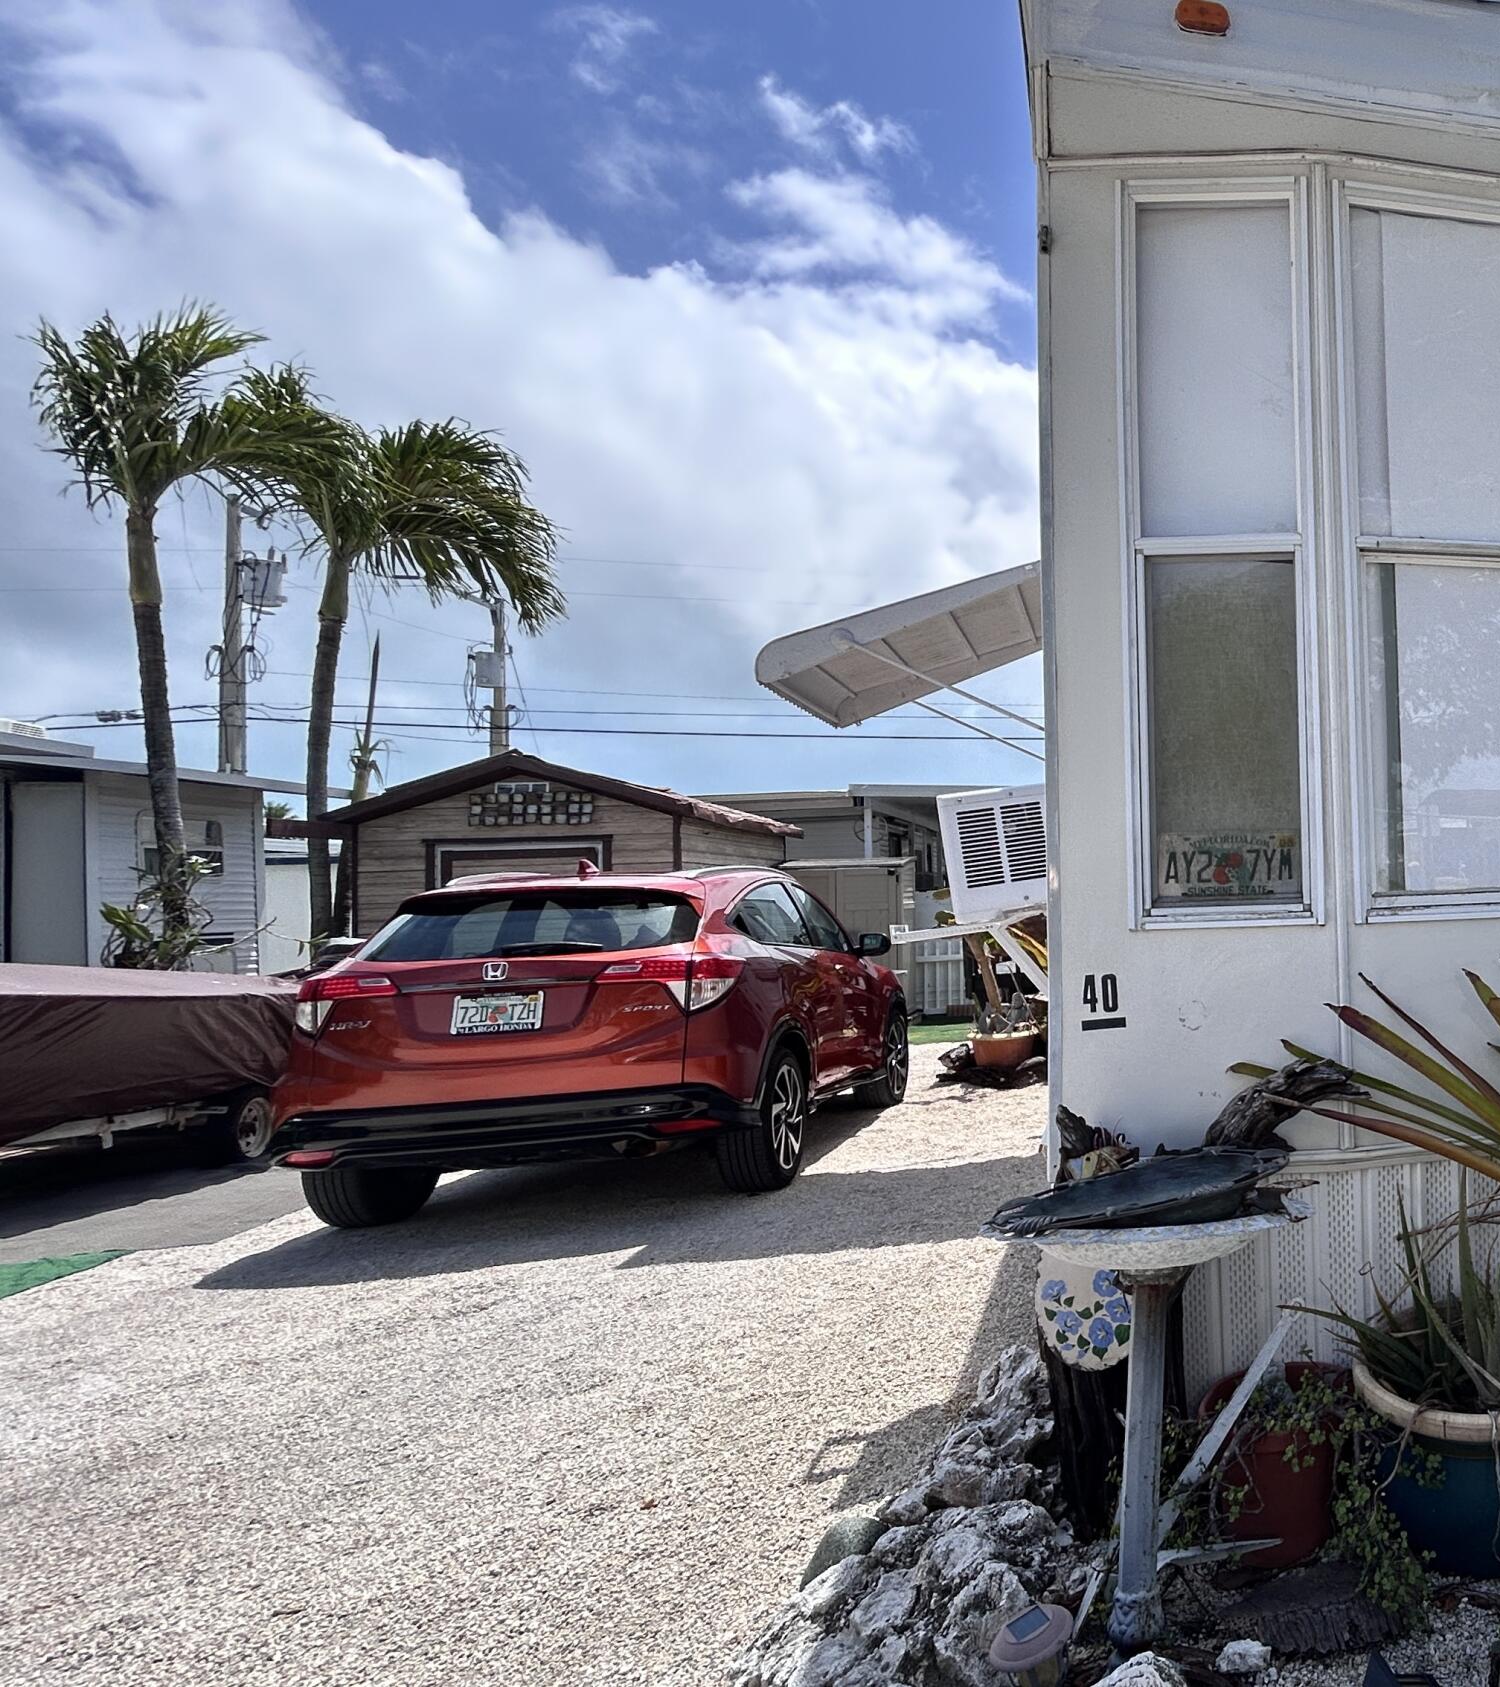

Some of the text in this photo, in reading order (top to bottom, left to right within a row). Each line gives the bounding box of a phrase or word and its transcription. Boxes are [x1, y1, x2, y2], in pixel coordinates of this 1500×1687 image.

[1165, 848, 1293, 884] AY2 7YM
[1187, 884, 1268, 897] SUNSHINE STATE
[1082, 973, 1119, 1013] 40
[509, 1003, 537, 1021] TZH
[622, 1004, 672, 1013] SPORT
[464, 1024, 498, 1034] LARGO
[499, 1023, 532, 1032] HONDA
